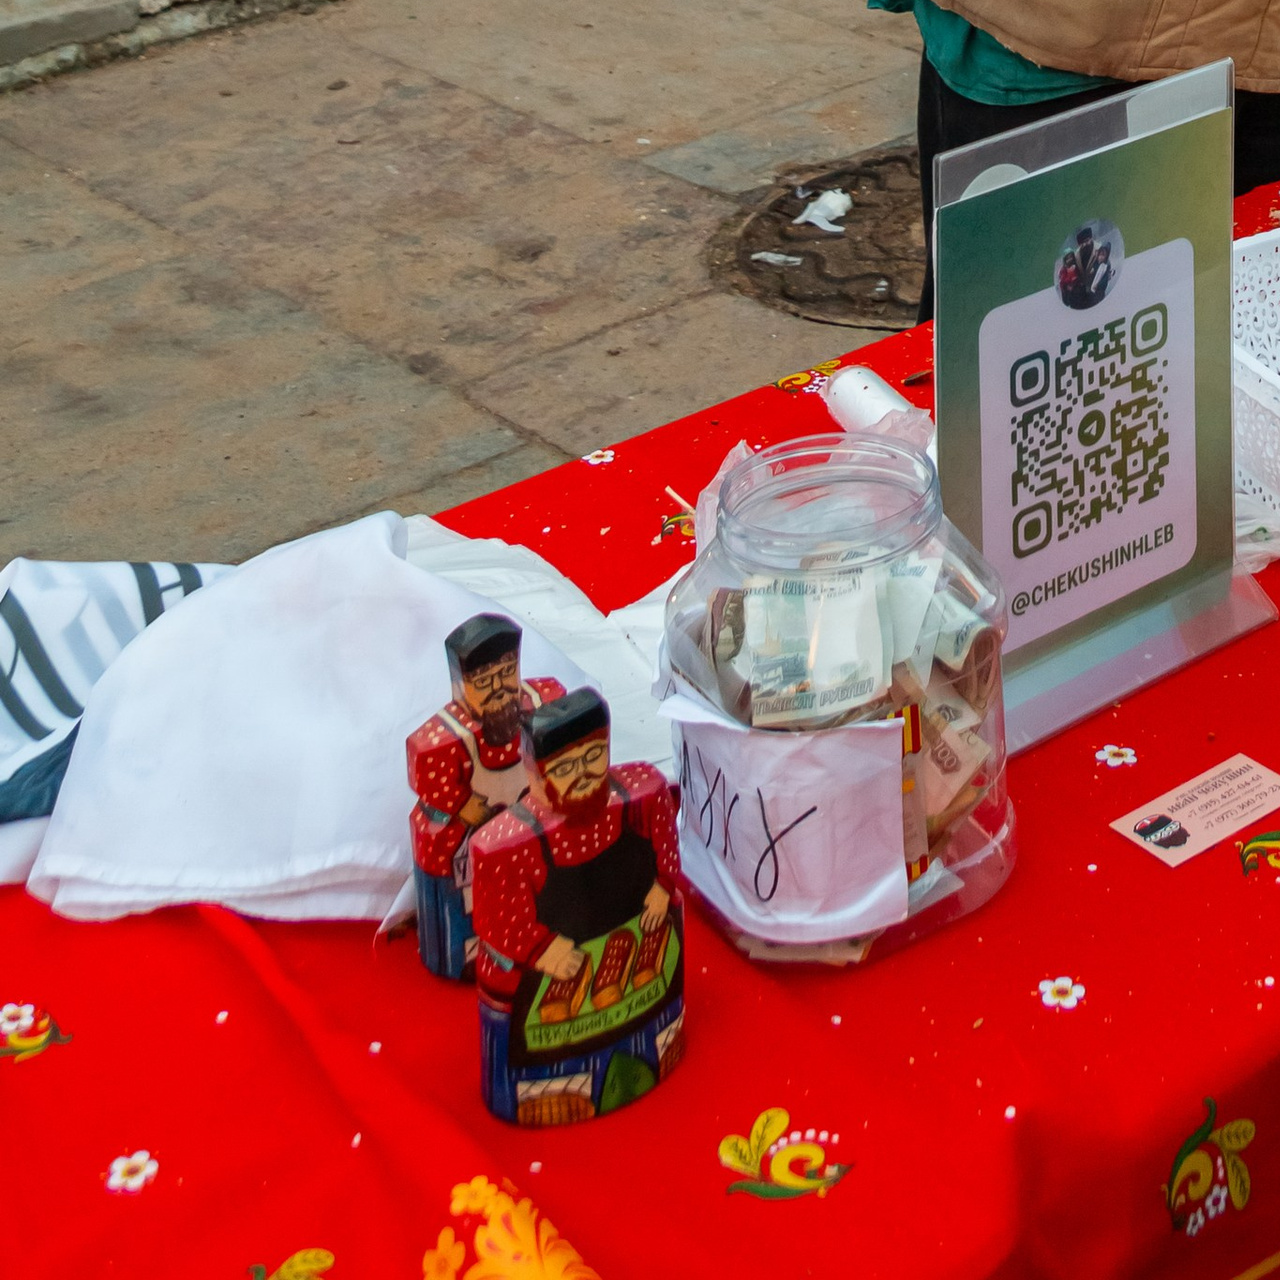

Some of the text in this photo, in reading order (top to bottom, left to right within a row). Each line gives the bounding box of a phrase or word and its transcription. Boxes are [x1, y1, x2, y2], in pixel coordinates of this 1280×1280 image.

[1011, 523, 1175, 616] @CHEKUSHINHLEB
[931, 740, 957, 768] 100
[1166, 793, 1199, 814] ИВАН
[1197, 763, 1254, 796] ЧЕКУШИН
